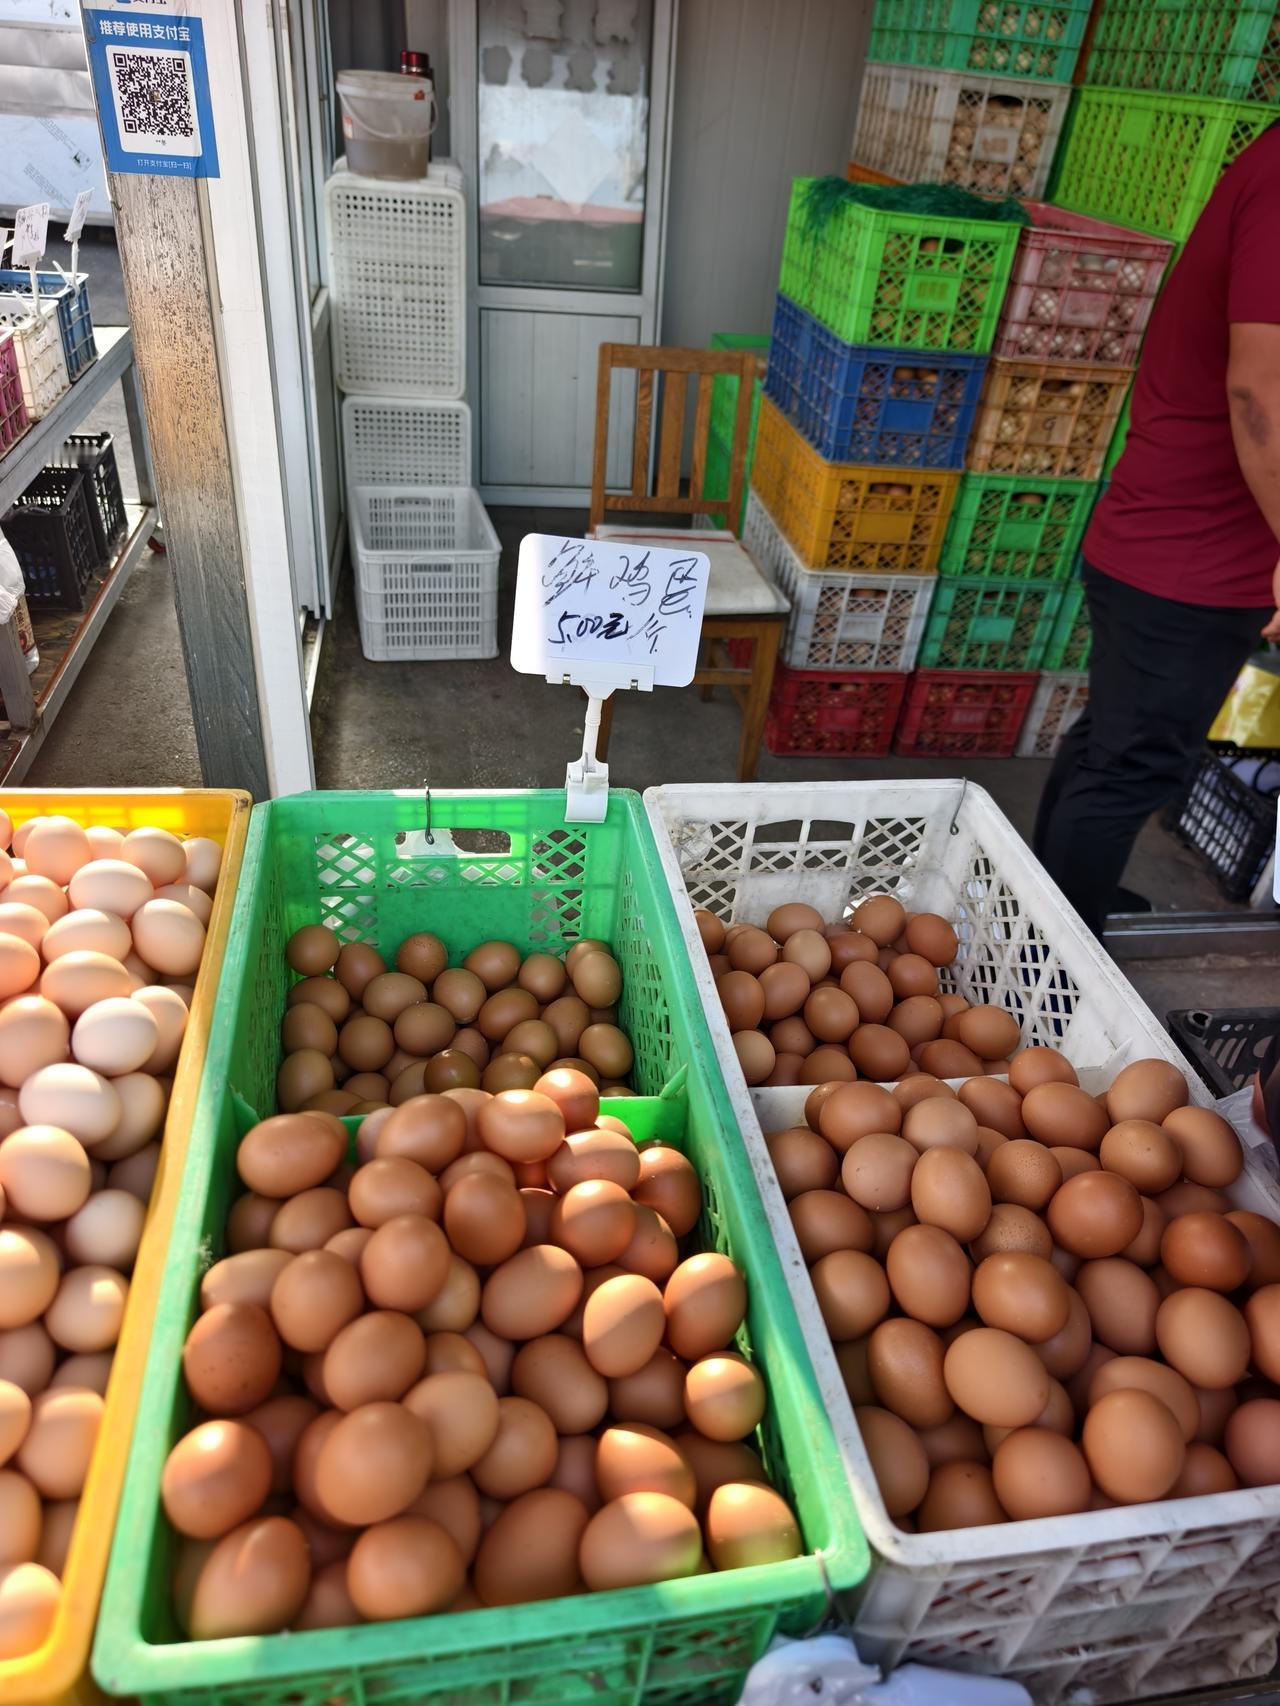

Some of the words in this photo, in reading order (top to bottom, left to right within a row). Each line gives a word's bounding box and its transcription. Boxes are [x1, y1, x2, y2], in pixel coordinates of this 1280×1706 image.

[100, 20, 191, 41] 推荐使用支付宝
